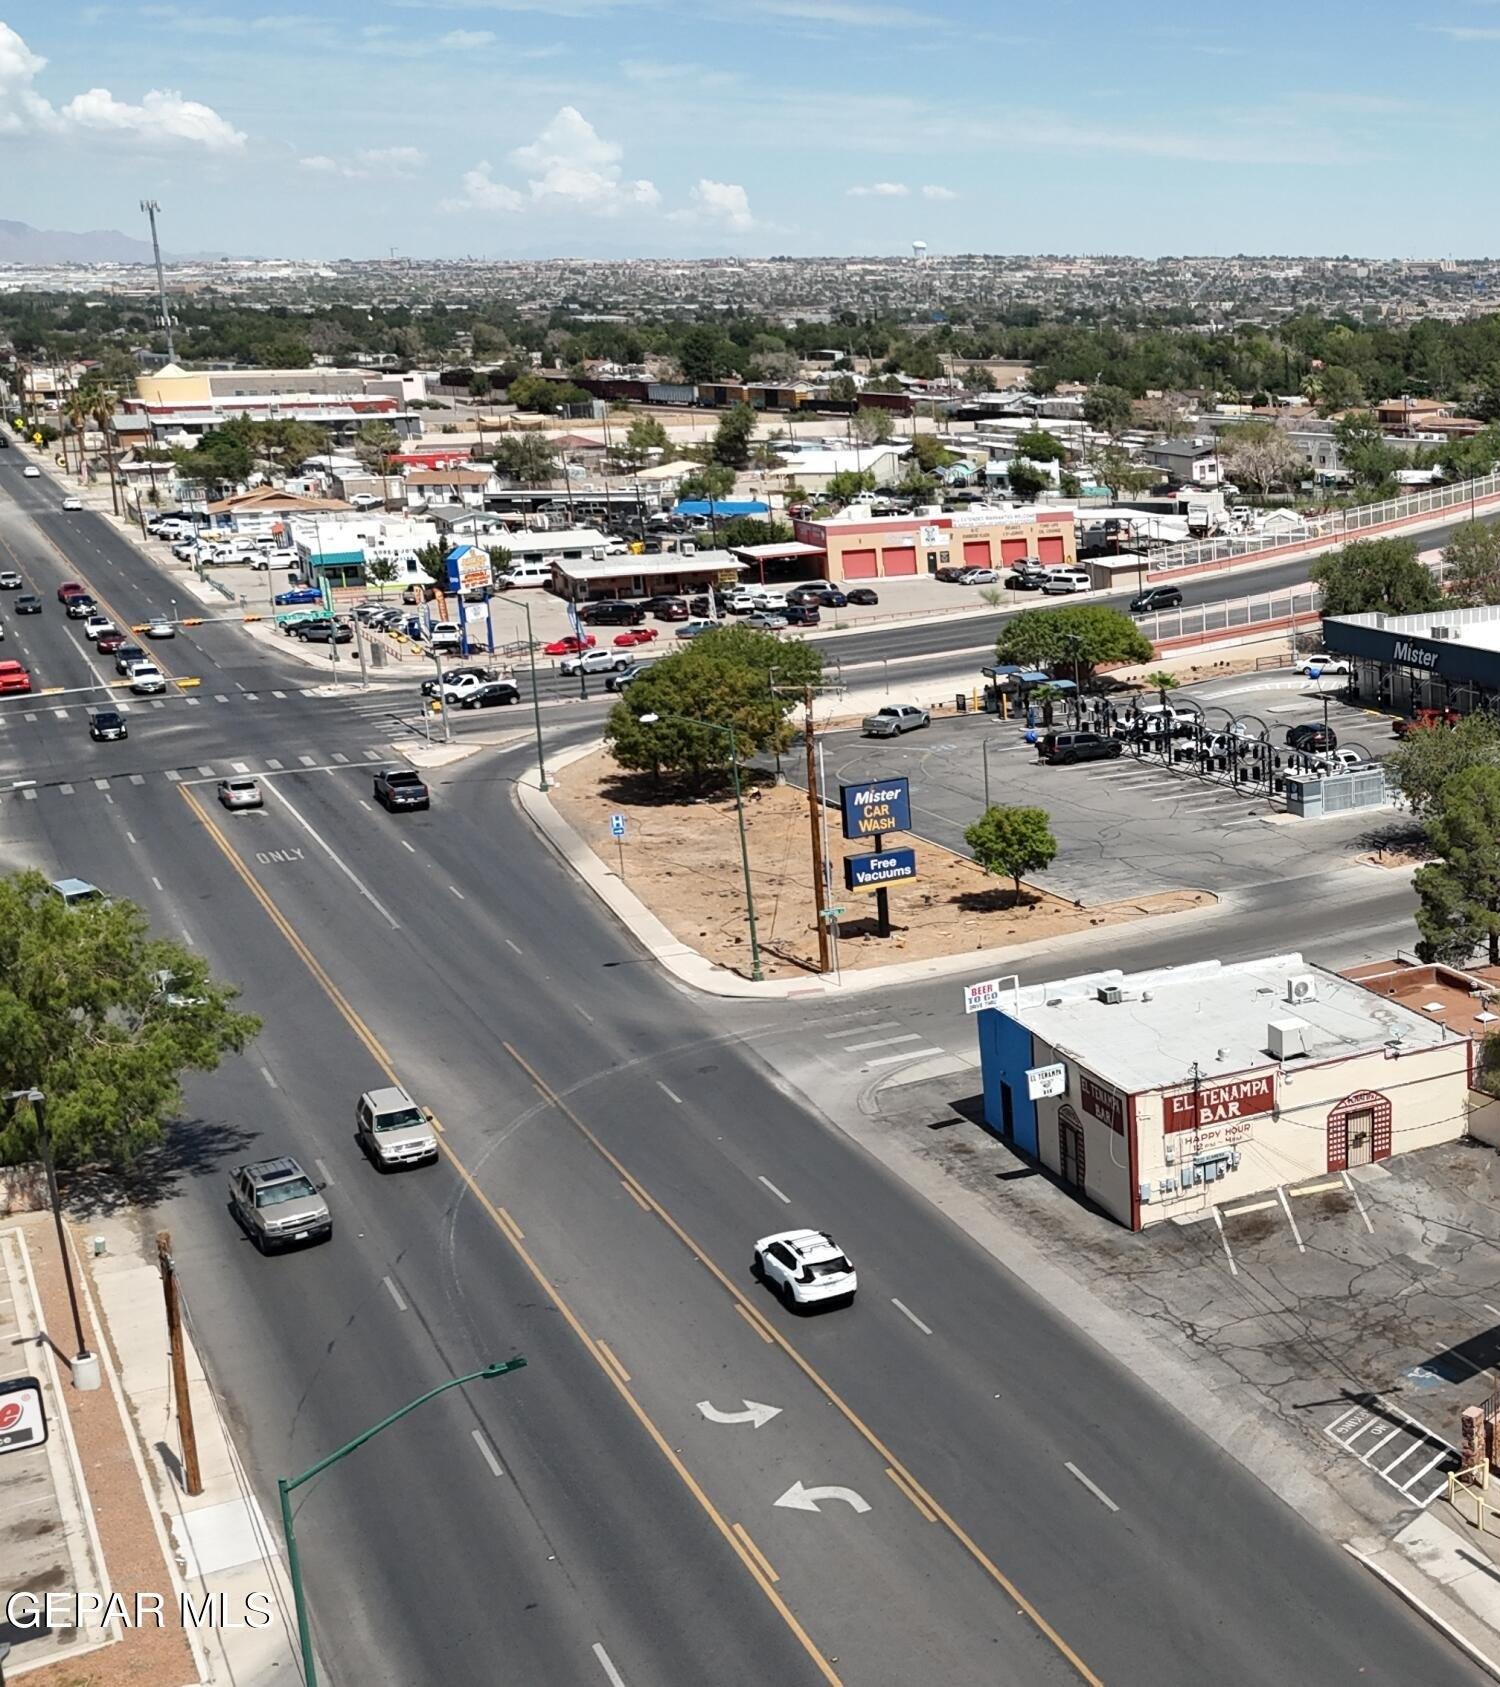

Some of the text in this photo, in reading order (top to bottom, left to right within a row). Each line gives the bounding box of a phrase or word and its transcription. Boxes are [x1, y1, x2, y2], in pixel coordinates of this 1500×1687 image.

[1393, 641, 1439, 668] Mister
[854, 788, 902, 806] Mister
[863, 804, 891, 818] CAR
[858, 816, 896, 833] WASH
[255, 847, 304, 865] ONLY
[870, 858, 897, 871] Free
[856, 866, 912, 883] Vacuums
[968, 991, 998, 1005] TO GO
[971, 984, 993, 997] BEER
[1172, 1079, 1270, 1113] EL TENAMPA
[1200, 1102, 1242, 1125] BAR
[1184, 1123, 1251, 1145] HAPPY HOUR
[1370, 1423, 1389, 1435] NO
